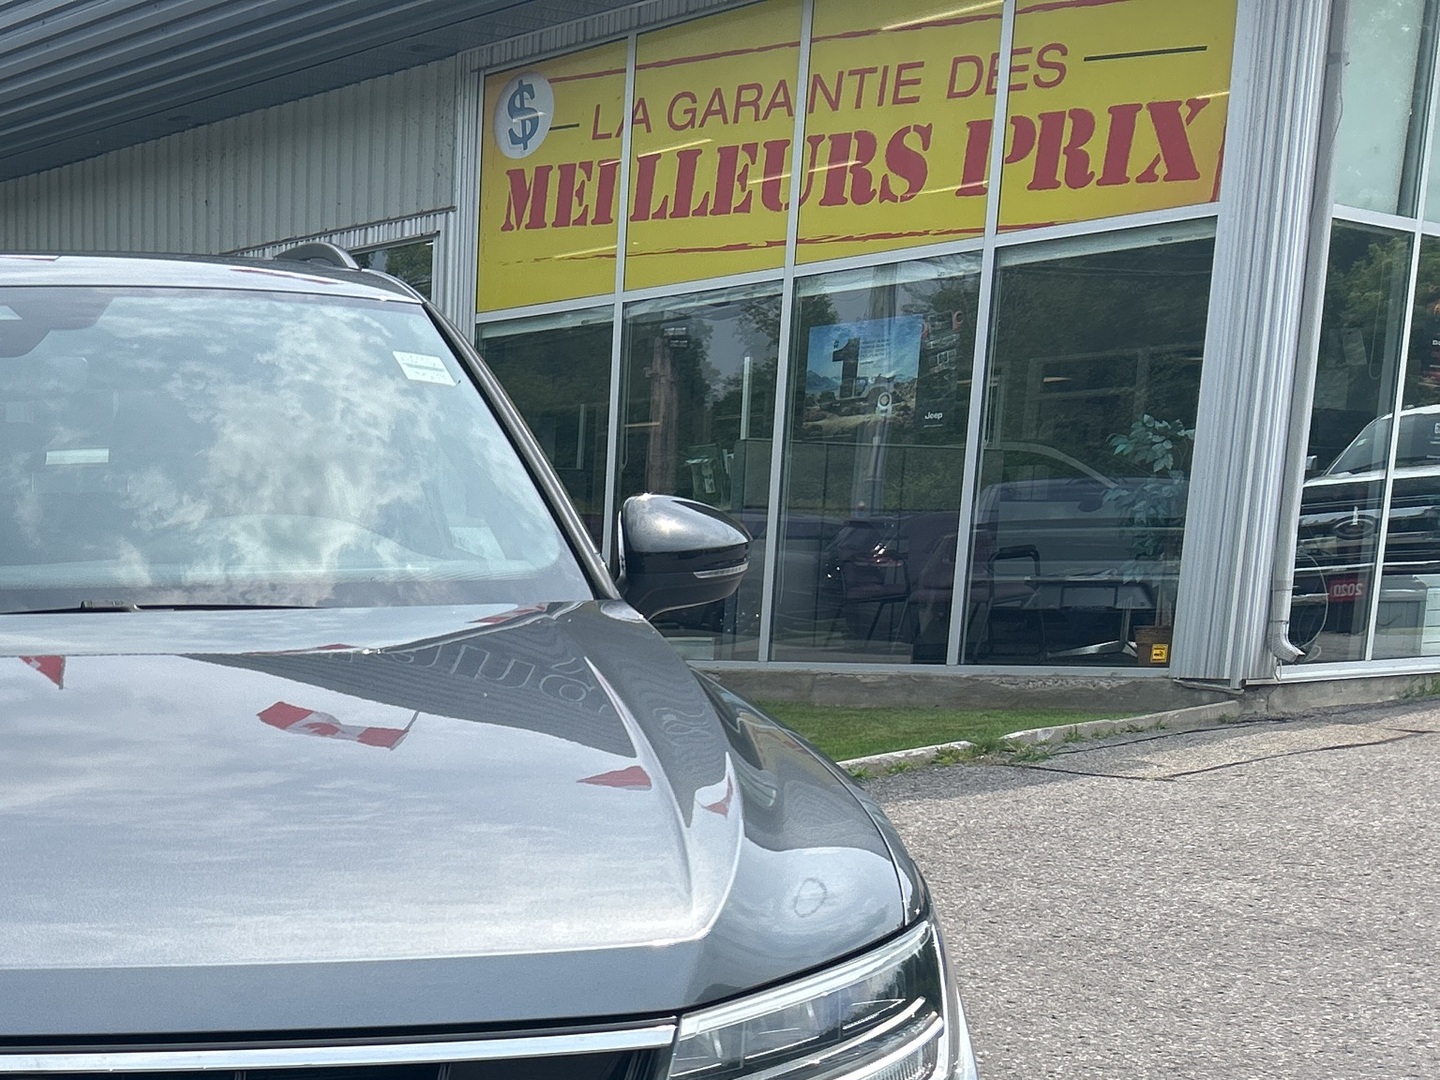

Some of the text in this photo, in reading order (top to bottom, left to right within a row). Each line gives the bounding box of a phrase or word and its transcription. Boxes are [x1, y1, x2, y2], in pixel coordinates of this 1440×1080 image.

[592, 43, 1069, 141] LA GARANTIE DES
[501, 98, 1211, 232] MEILLEURS PRIX
[924, 411, 943, 420] Jeep
